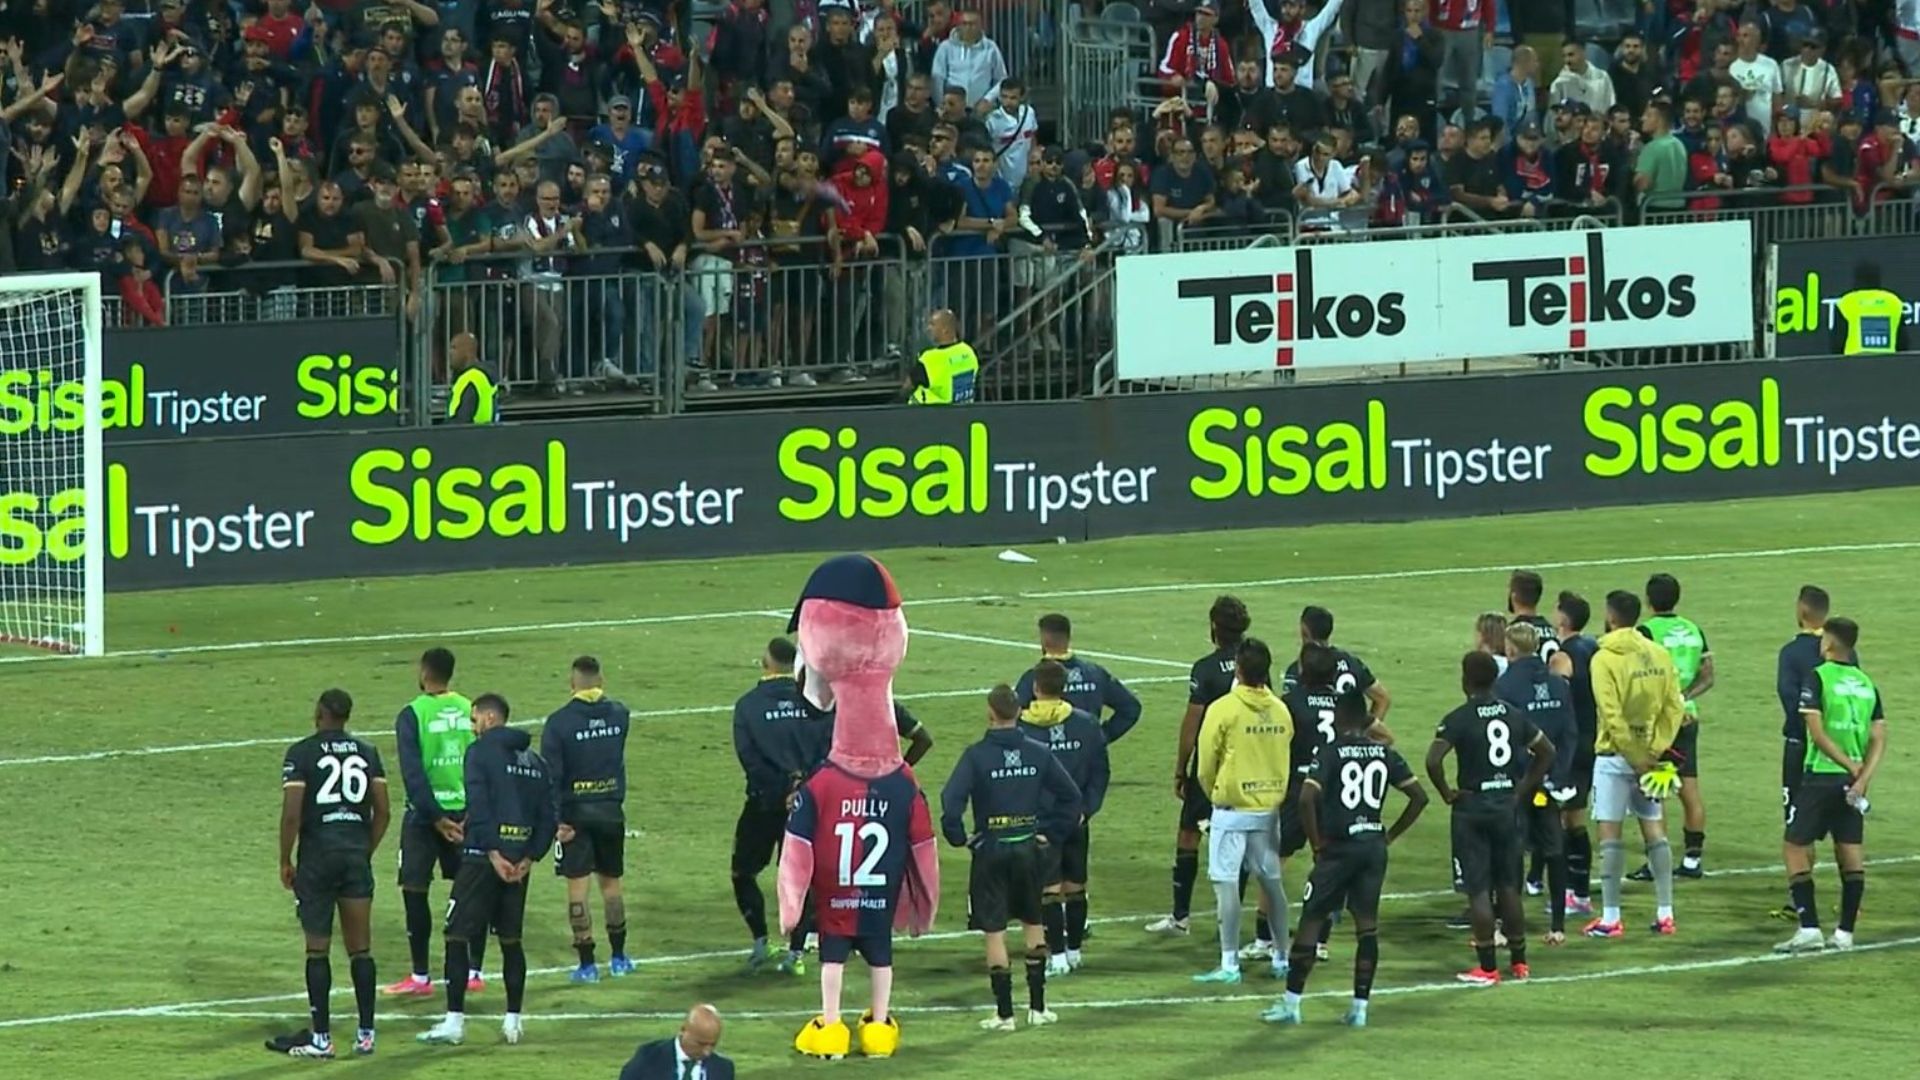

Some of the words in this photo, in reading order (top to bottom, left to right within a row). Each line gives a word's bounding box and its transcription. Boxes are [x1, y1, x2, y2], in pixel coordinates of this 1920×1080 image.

[1178, 248, 1406, 365] Teikos
[1473, 232, 1695, 348] Teikos
[0, 363, 144, 434] Sisal
[148, 390, 267, 435] Tipster
[297, 354, 398, 418] Sis
[1188, 400, 1387, 500] Sisal
[1391, 438, 1552, 499] Tipster
[1584, 377, 1780, 476] Sisal
[1785, 416, 1920, 475] Tipste
[350, 440, 566, 544] Sisal
[572, 480, 743, 543] Tipster
[778, 422, 988, 521] Sisal
[994, 460, 1157, 524] Tipster
[0, 463, 128, 565] sal
[135, 504, 314, 568] Tipster
[1062, 683, 1097, 693] AMED
[575, 726, 621, 741] BEAMED
[1048, 740, 1081, 751] AMED
[1245, 725, 1286, 735] BEAMED
[1486, 719, 1512, 767] 8
[316, 754, 368, 804] 26
[991, 766, 1038, 779] BEAMED
[1340, 759, 1388, 809] 80
[841, 799, 888, 817] PULLY
[834, 822, 889, 887] 12
